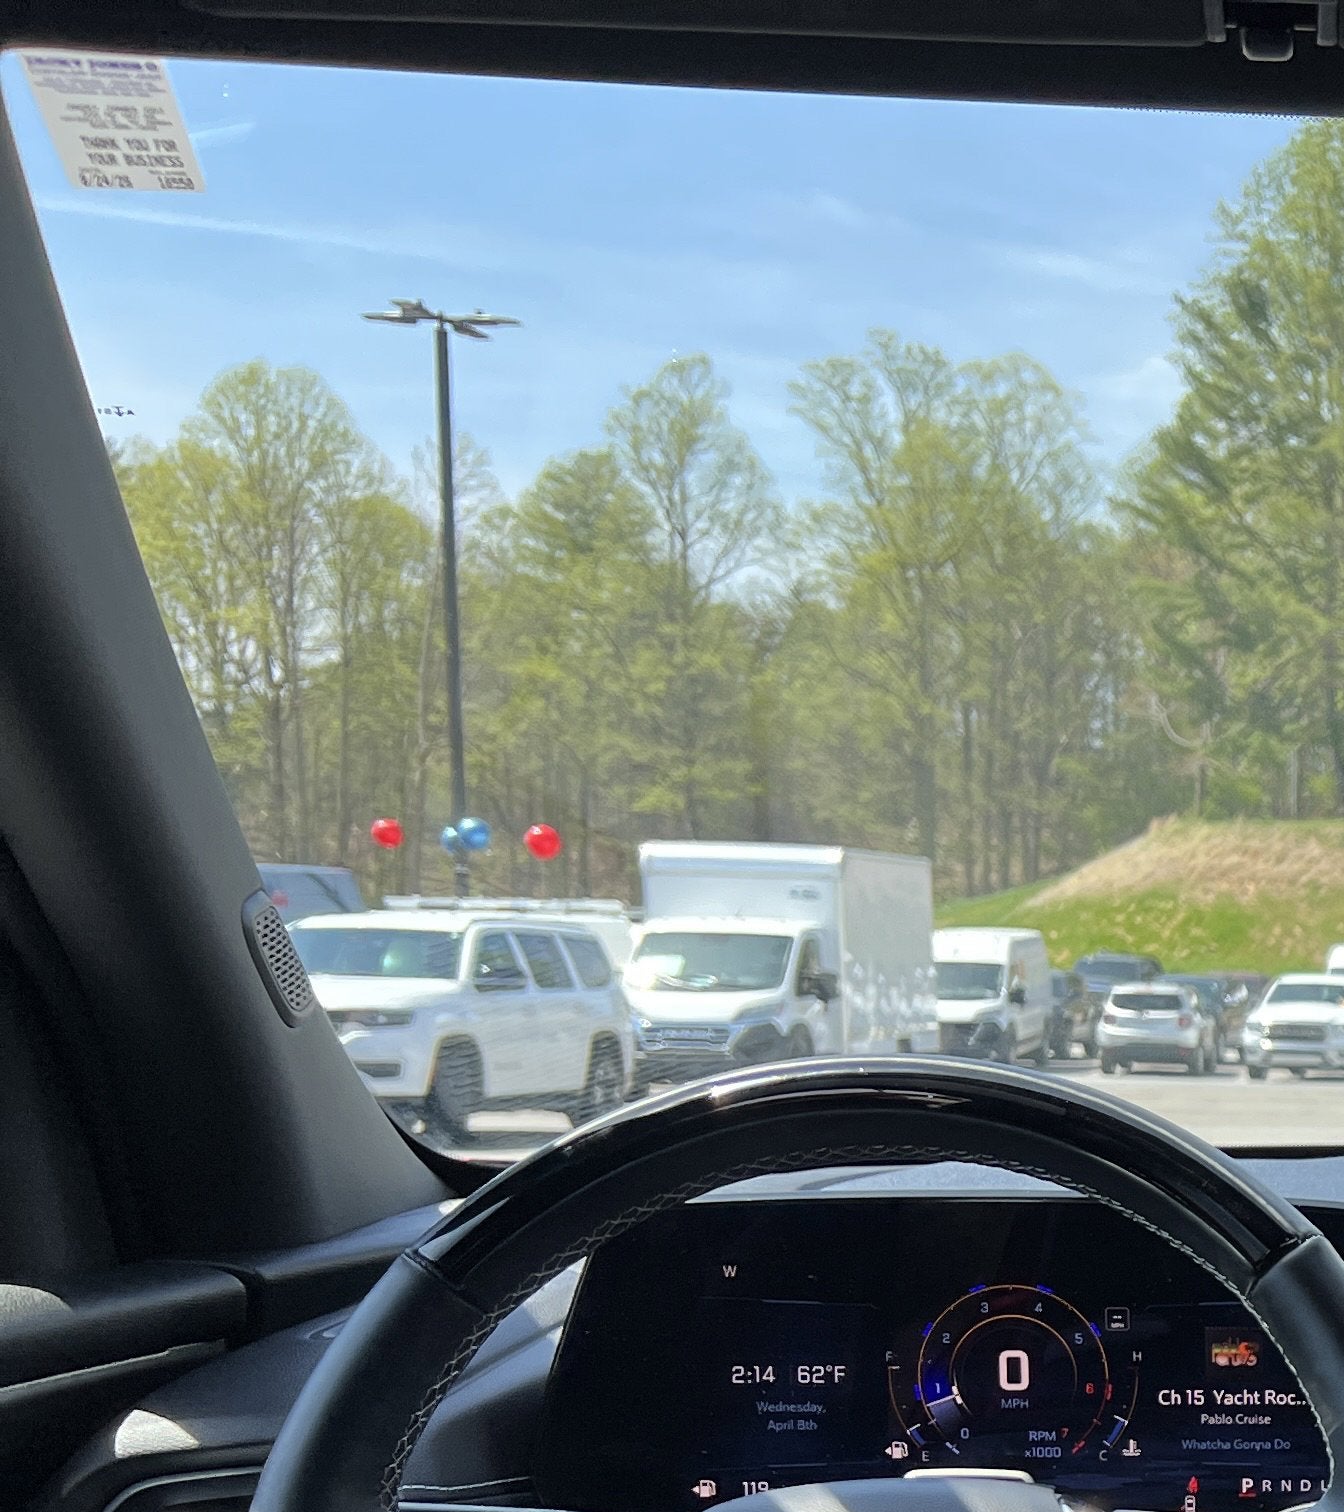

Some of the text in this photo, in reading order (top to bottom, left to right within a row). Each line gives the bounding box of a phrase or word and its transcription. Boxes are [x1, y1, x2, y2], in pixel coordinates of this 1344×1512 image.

[123, 153, 184, 168] BUSINESS
[722, 1264, 737, 1278] W
[980, 1302, 989, 1314] 3
[1034, 1302, 1043, 1314] 4
[942, 1332, 951, 1344] 2
[1074, 1332, 1083, 1345] 5
[1132, 1350, 1142, 1362] H
[731, 1365, 847, 1384] 2:14 62°F
[998, 1349, 1030, 1391] 0
[1086, 1382, 1095, 1395] 6
[1158, 1389, 1182, 1406] Ch
[1187, 1389, 1206, 1406] 15
[1212, 1388, 1261, 1406] Yacht
[756, 1400, 827, 1414] Wednesday,
[1000, 1398, 1030, 1410] MPH
[767, 1419, 818, 1432] April 8th
[1200, 1413, 1272, 1425] Pablo Cruise
[960, 1427, 970, 1440] 0
[1028, 1430, 1057, 1443] RPM
[1061, 1426, 1070, 1438] 7
[1181, 1438, 1291, 1451] Whatcha Gonna Do
[921, 1450, 931, 1462] E
[1025, 1446, 1062, 1459] x1000
[1099, 1450, 1109, 1462] C
[742, 1481, 770, 1498] 119
[1241, 1477, 1254, 1493] P
[1262, 1479, 1273, 1492] R
[1281, 1479, 1292, 1492] N
[1300, 1479, 1311, 1492] D
